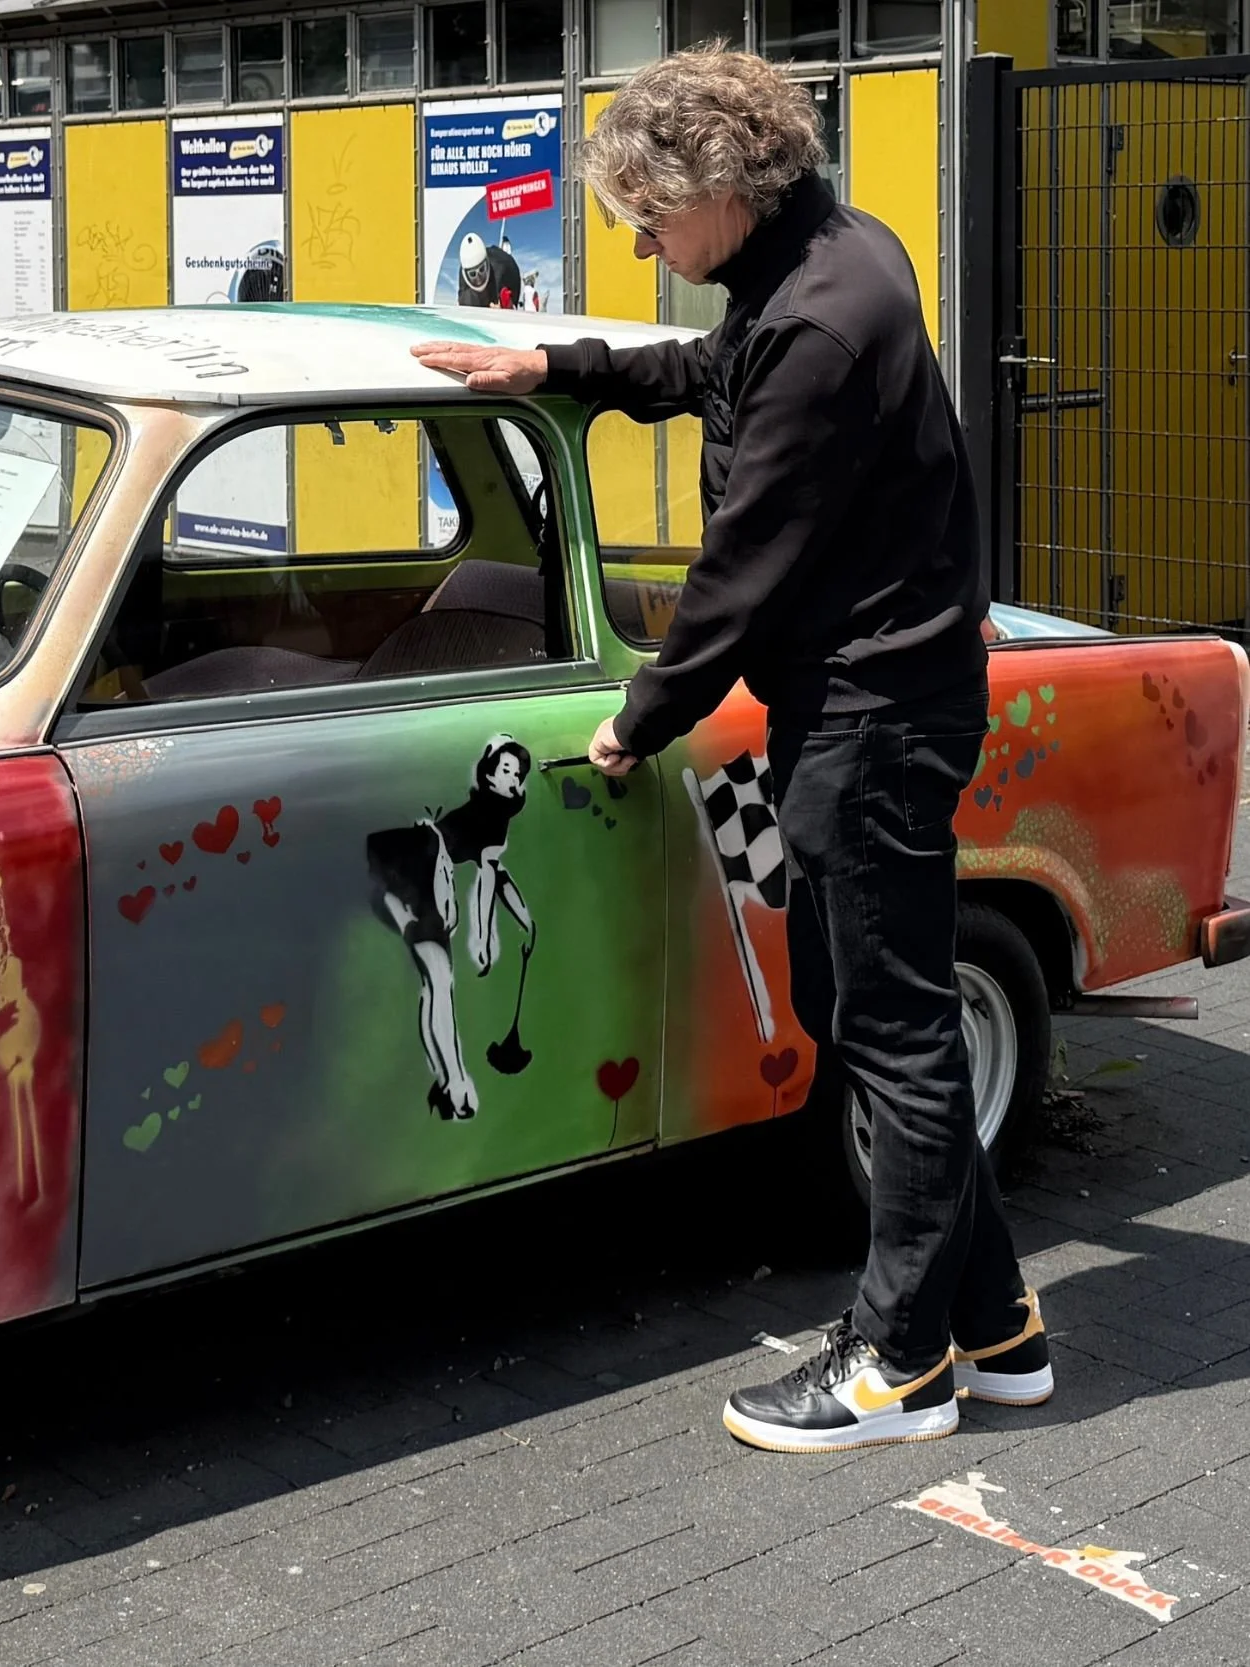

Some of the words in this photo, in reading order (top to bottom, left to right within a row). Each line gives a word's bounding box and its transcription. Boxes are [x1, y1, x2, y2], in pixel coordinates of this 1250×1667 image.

[180, 137, 227, 155] Weltballon
[431, 145, 446, 160] FÜR
[446, 147, 466, 161] ALLE,
[467, 146, 481, 159] DIE
[481, 145, 503, 158] NOCH
[504, 141, 531, 158] HÖHER
[431, 162, 459, 176] HINAUS
[459, 161, 489, 174] WOLLEN
[185, 256, 272, 271] Geschenkgutscheine
[1076, 1564, 1181, 1610] DUCK
